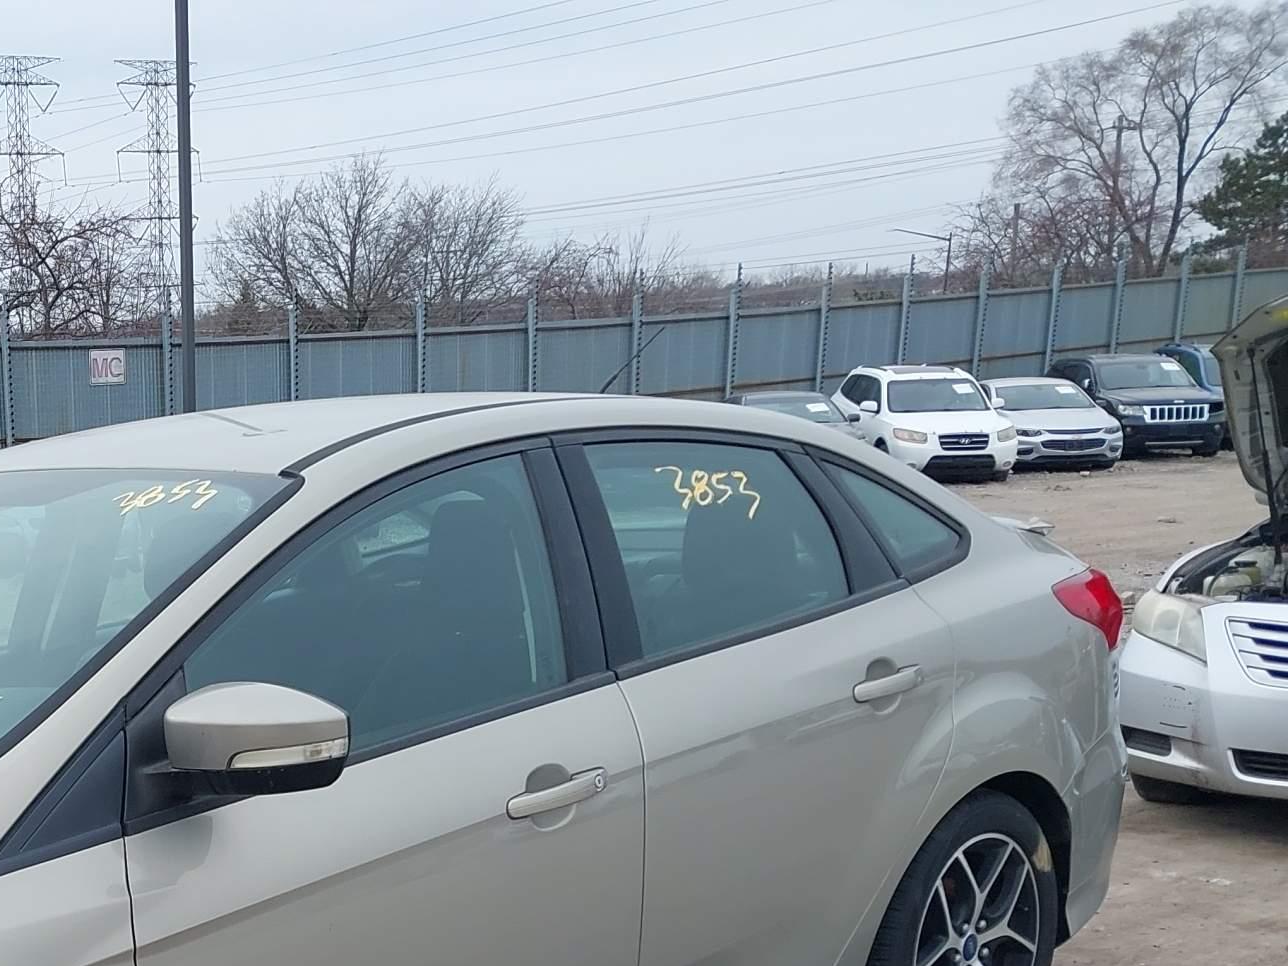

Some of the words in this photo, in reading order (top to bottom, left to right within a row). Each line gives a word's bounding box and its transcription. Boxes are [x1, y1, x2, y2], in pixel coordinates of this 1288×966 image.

[92, 356, 123, 379] MC
[112, 478, 217, 517] 3853
[654, 465, 761, 520] 3853
